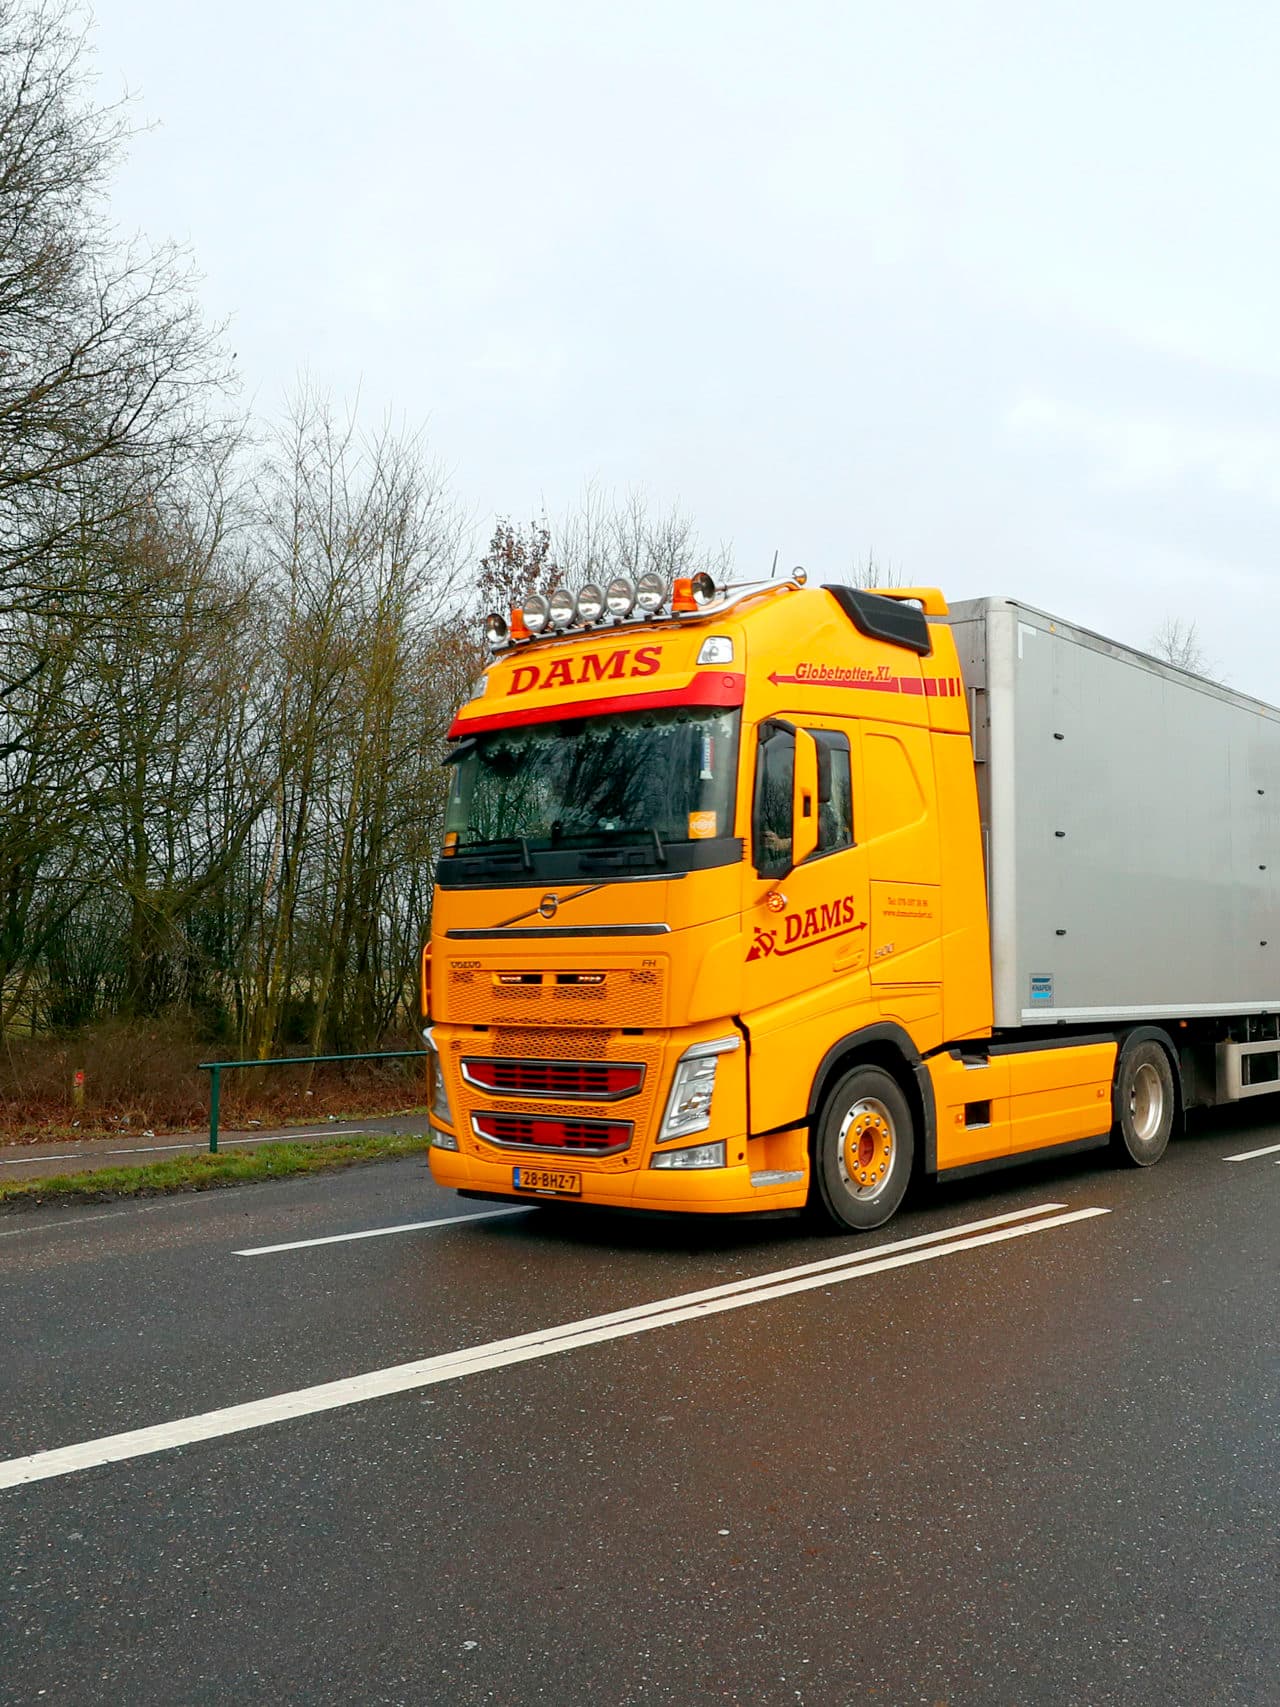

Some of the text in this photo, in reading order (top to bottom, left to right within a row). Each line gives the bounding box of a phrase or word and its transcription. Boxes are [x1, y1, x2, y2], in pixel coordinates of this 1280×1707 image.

[506, 646, 662, 696] DAMS
[796, 662, 892, 682] Globetrotter XL
[785, 895, 855, 944] DAMS
[523, 1171, 576, 1190] 28-BHZ-7
